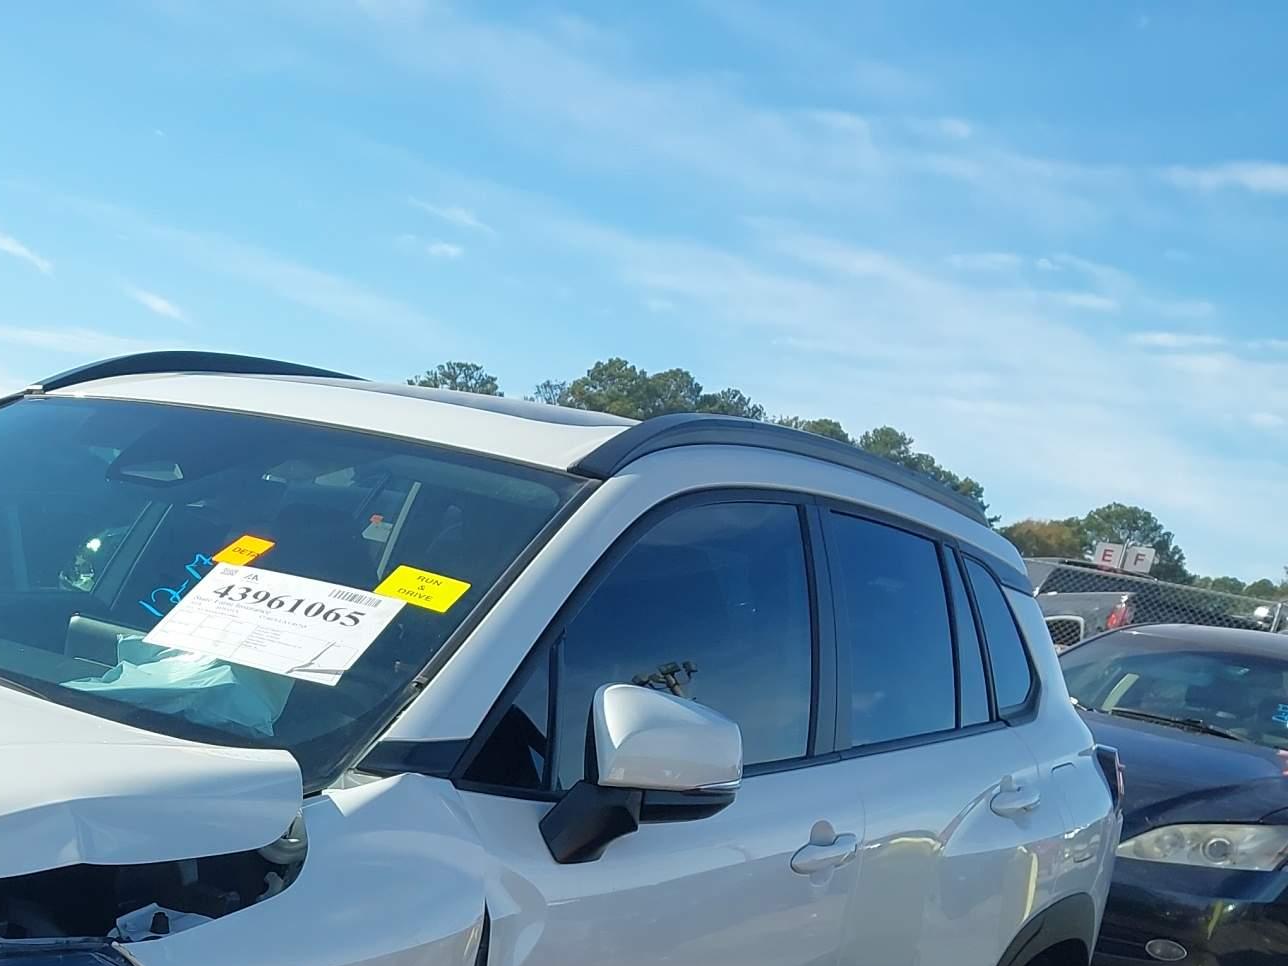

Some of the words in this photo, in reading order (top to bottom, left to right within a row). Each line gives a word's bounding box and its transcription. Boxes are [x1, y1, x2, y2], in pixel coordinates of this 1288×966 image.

[1101, 549, 1115, 562] E
[1134, 553, 1146, 565] F
[417, 575, 443, 586] RUN
[397, 588, 434, 602] DRIVE
[213, 584, 366, 627] 43961065
